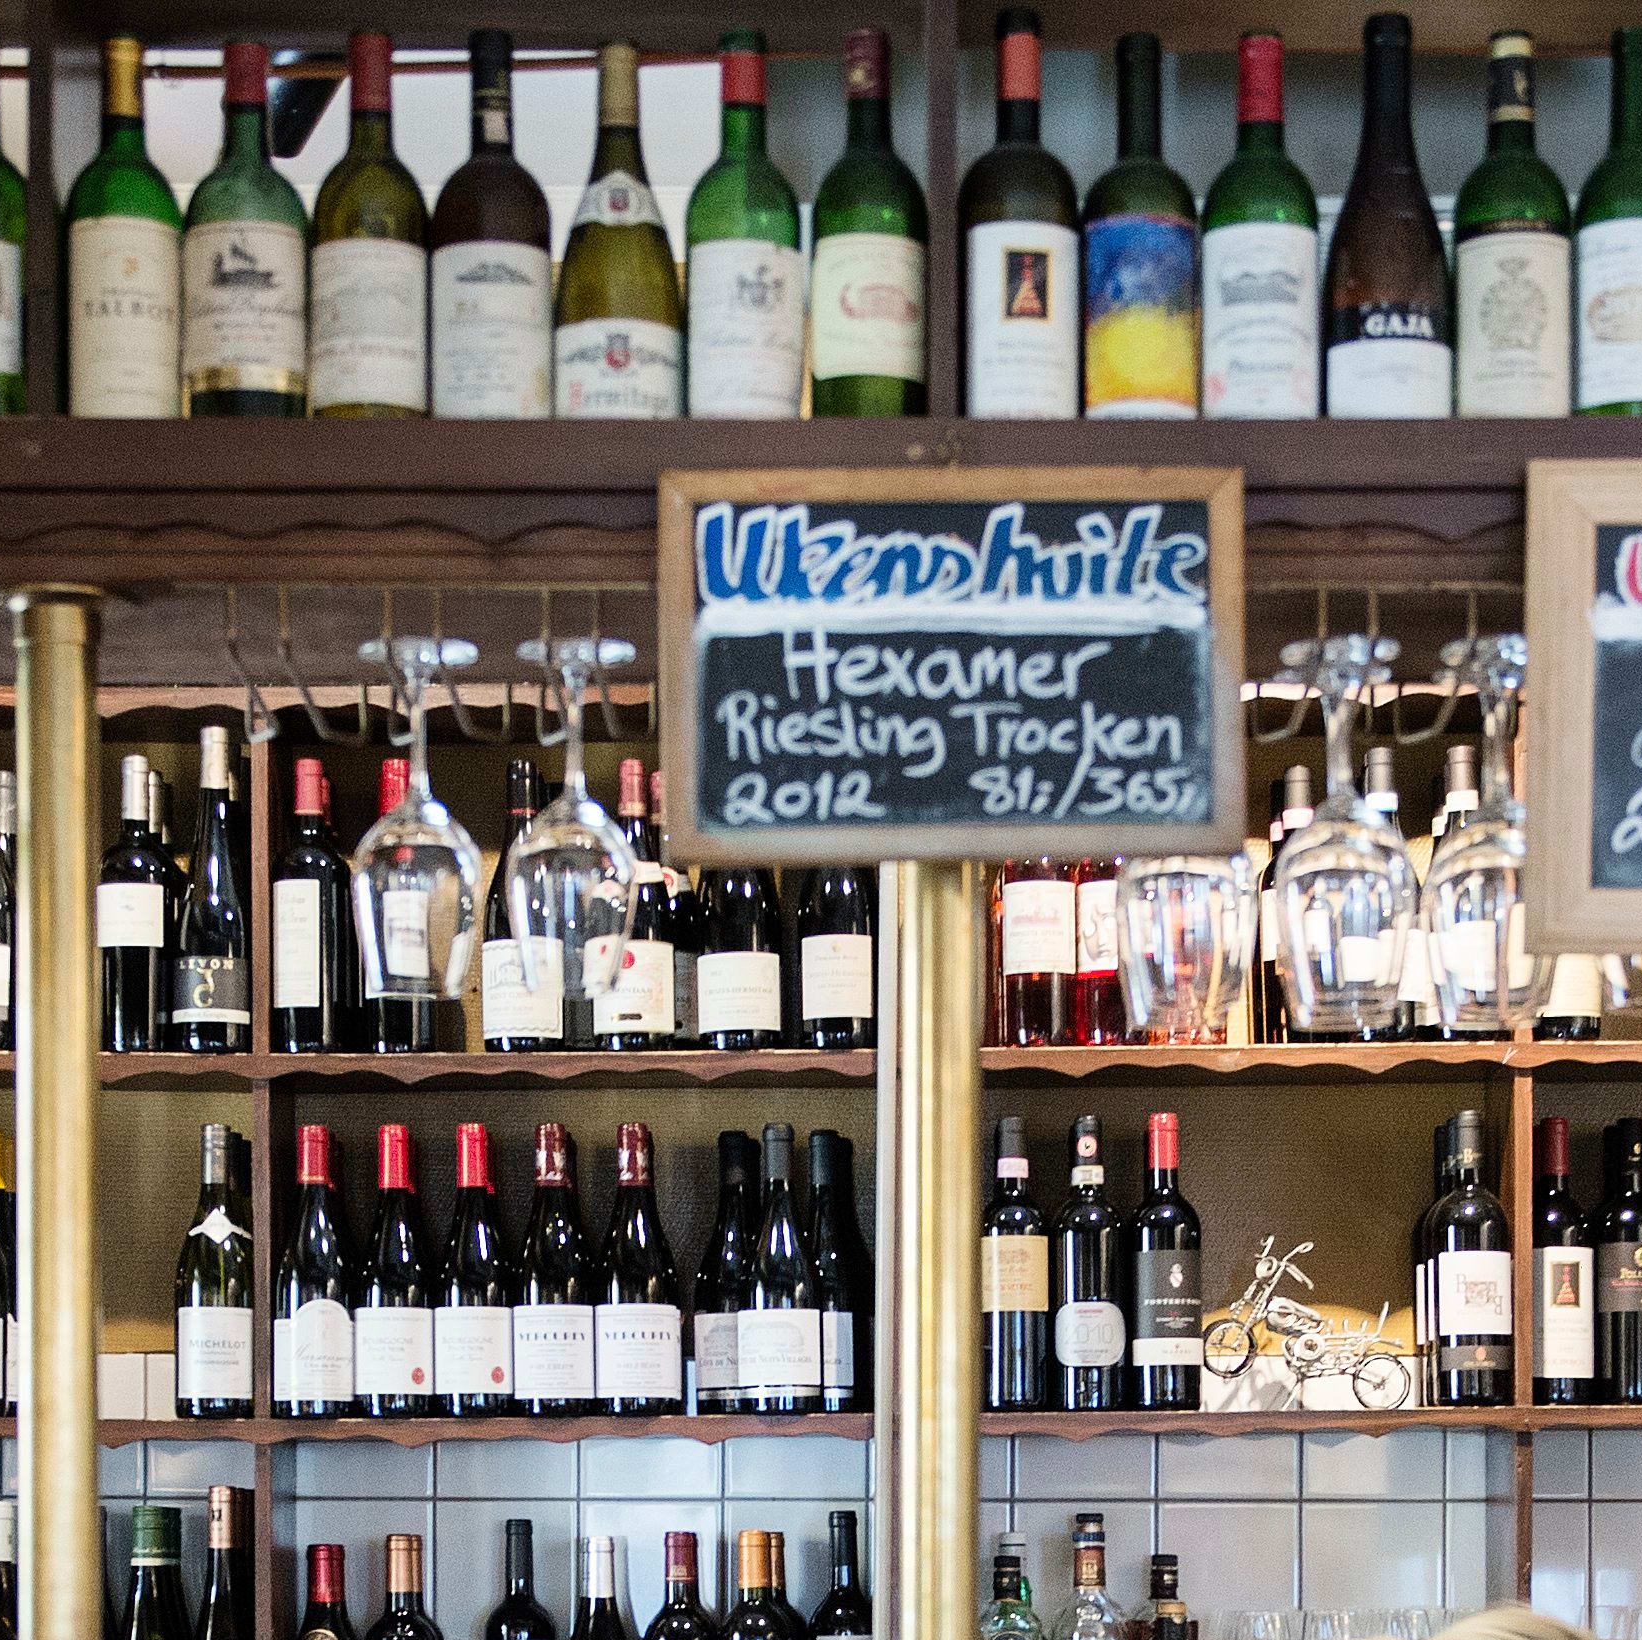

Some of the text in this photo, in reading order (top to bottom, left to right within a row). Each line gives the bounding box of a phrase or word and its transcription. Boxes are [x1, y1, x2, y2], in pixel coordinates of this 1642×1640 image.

[1364, 313, 1434, 336] GAJA
[782, 630, 1111, 702] Hexamer
[717, 689, 1182, 779] Riesling Trocken
[722, 770, 887, 825] 2012
[188, 1339, 247, 1351] MICHELOT
